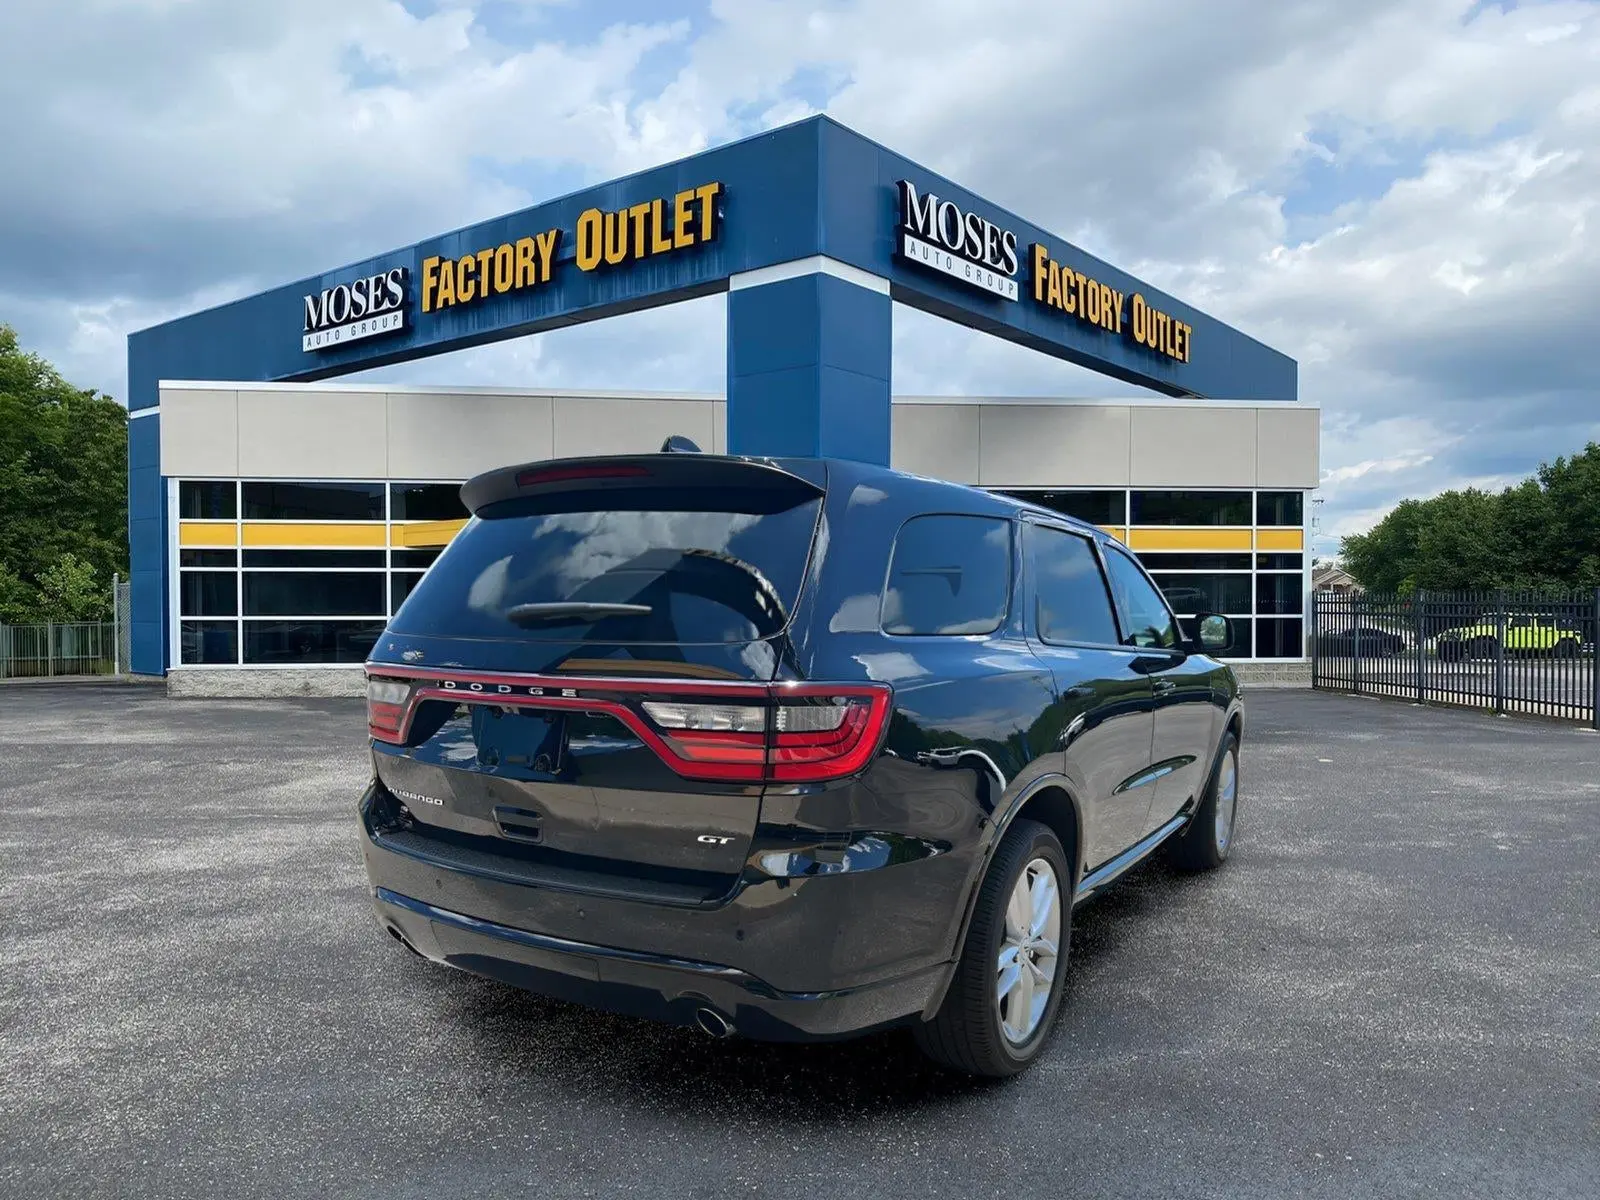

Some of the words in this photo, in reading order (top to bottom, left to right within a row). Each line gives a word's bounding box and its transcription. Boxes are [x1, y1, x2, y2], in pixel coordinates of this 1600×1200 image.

[421, 228, 558, 313] FACTORY
[576, 181, 721, 271] OUTLET
[904, 179, 1018, 276] MOSES
[909, 241, 952, 270] AUTO
[965, 264, 1014, 295] GROUP
[303, 267, 404, 332] MOSES
[1034, 243, 1124, 334] FACTORY
[1131, 293, 1192, 364] OUTLET
[306, 329, 340, 348] AUTO
[350, 314, 399, 337] GROUP
[444, 680, 577, 698] DODGE
[697, 834, 736, 845] GT
